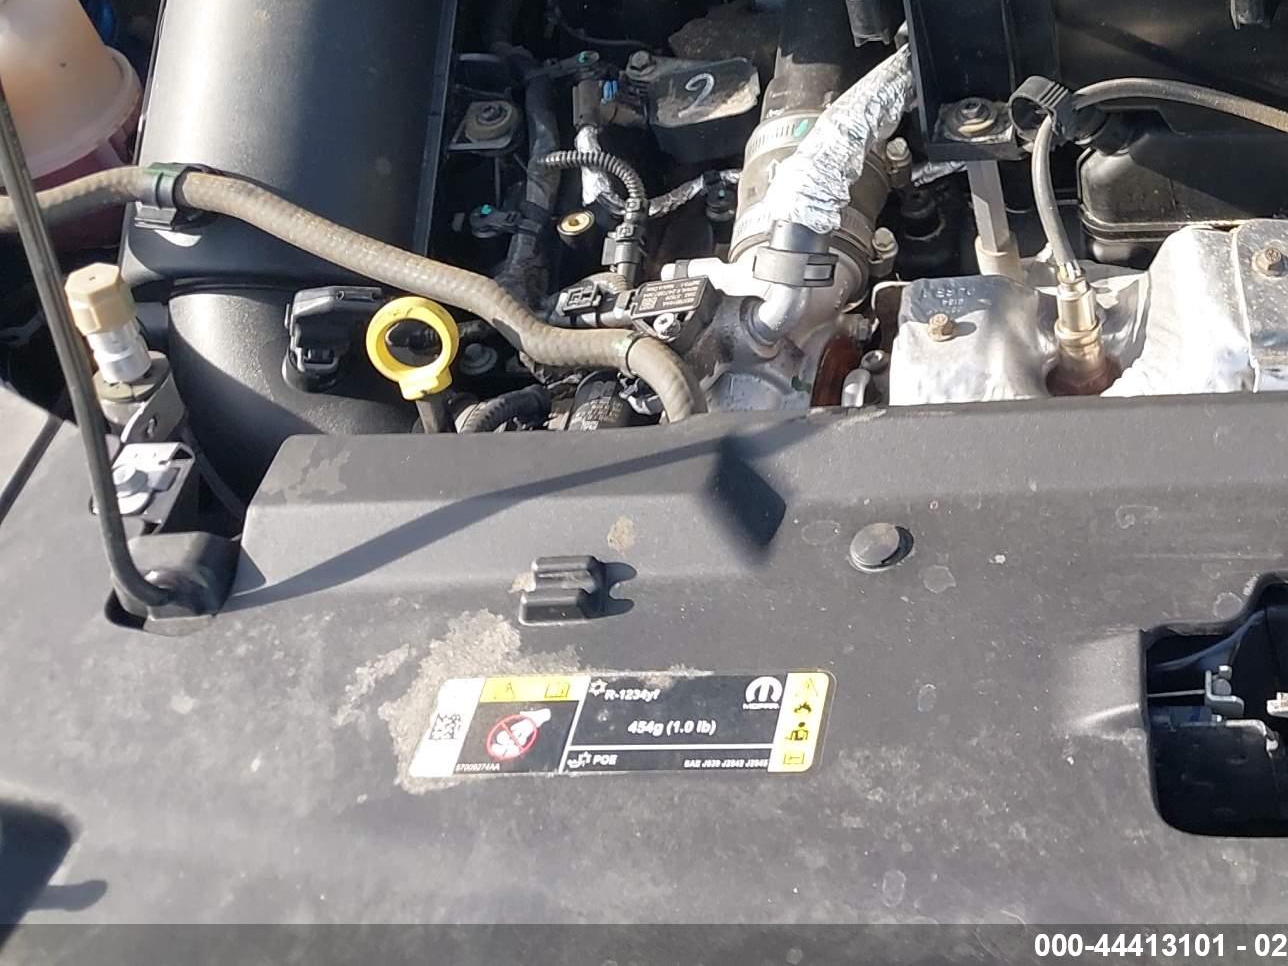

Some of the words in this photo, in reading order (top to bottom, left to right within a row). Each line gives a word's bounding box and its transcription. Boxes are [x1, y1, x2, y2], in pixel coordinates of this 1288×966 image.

[604, 688, 661, 702] R-1234yf
[627, 720, 665, 736] 454g
[592, 754, 617, 765] POE
